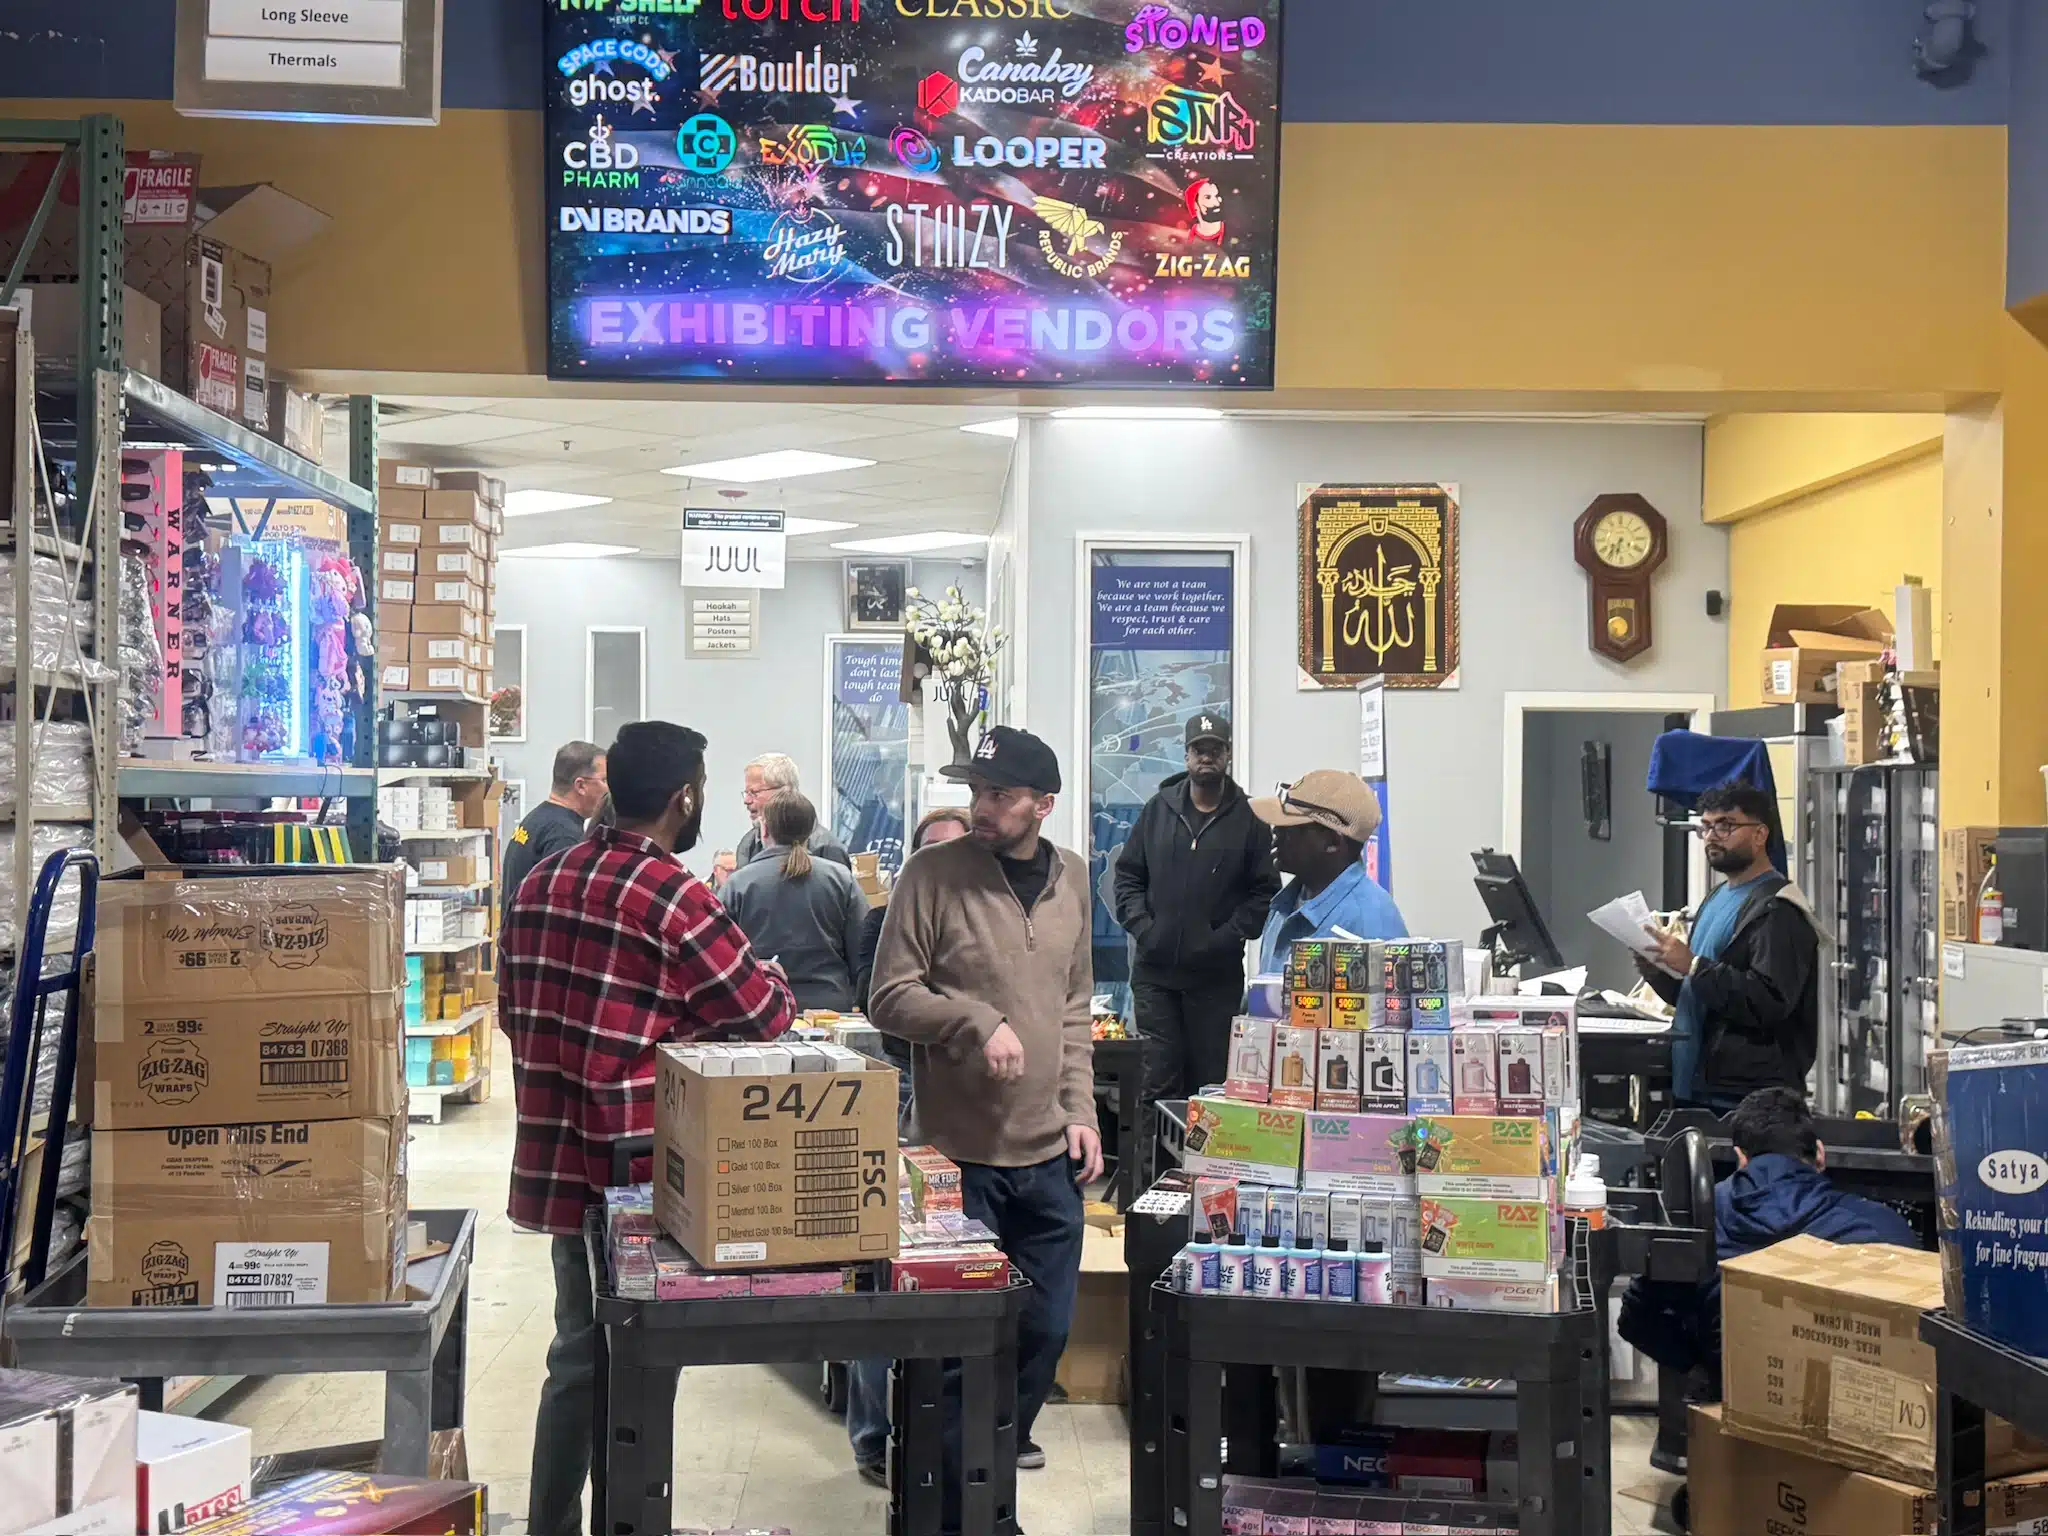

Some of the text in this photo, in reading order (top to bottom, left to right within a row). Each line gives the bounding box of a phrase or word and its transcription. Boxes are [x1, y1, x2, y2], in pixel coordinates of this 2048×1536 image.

[261, 8, 349, 24] Long Sleeve
[895, 0, 1073, 20] CLASSIC
[1124, 3, 1266, 53] STONED
[268, 53, 337, 67] Thermals
[558, 38, 671, 82] SPACE GODS
[740, 44, 858, 94] Boulder
[957, 46, 1094, 97] Canabzy
[569, 73, 661, 106] ghost.
[960, 86, 1054, 103] KADOBAR
[563, 142, 639, 170] CBD
[953, 135, 1107, 168] LOOPER
[1166, 152, 1233, 161] CREATIONS
[140, 168, 192, 187] FRAGILE
[563, 170, 639, 189] PHARM
[603, 207, 730, 235] BRANDS
[763, 223, 847, 260] Hazy
[766, 244, 847, 279] Mary
[1038, 229, 1124, 279] REPUBLIC BRANDS
[1154, 252, 1250, 278] ZIG-ZAG
[590, 300, 1236, 352] EXHIBITING VENDORS
[211, 348, 237, 373] FRAGILE
[705, 546, 761, 573] JUUL
[1116, 578, 1131, 589] We
[1154, 581, 1169, 589] not
[1182, 580, 1207, 589] team
[166, 507, 182, 679] WARNER
[1097, 590, 1225, 603] because we work together.
[1098, 602, 1112, 612] We
[1144, 603, 1168, 612] team
[1171, 602, 1209, 612] because
[1212, 604, 1225, 612] we
[1111, 614, 1210, 626] respect, trust & care
[707, 627, 737, 636] Posters
[1123, 625, 1196, 637] for each other.
[707, 641, 736, 649] Jackets
[844, 655, 876, 668] Tough
[850, 667, 877, 678] don't
[844, 680, 873, 692] tough
[869, 691, 883, 702] do
[1200, 716, 1213, 730] LA
[977, 735, 998, 759] LA
[276, 914, 314, 925] WRAPS
[193, 923, 256, 941] Straight
[144, 1020, 203, 1034] 2 99¢
[259, 1020, 321, 1039] Straight
[262, 1039, 349, 1057] 84762 07368
[141, 1057, 206, 1081] ZIG-ZAG
[154, 1084, 193, 1093] WRAPS
[742, 1077, 862, 1123] 24/7
[1257, 1111, 1296, 1130] RAZ
[1312, 1118, 1350, 1135] RAZ
[168, 1127, 219, 1149] Open
[271, 1124, 309, 1145] End
[1492, 1121, 1533, 1138] RAZ
[731, 1138, 778, 1149] Red 100 Box
[731, 1160, 780, 1172] Gold 100 Box
[1988, 1158, 2039, 1185] Satya
[863, 1150, 887, 1208] FSC
[928, 1171, 958, 1185] MR FOG
[731, 1182, 783, 1194] Silver 100 Box
[731, 1204, 783, 1216] Menthol 100 Box
[1497, 1204, 1539, 1222] RAZ
[731, 1227, 755, 1239] Menthol
[756, 1227, 769, 1237] Gold
[783, 1226, 794, 1235] Box
[1965, 1209, 2016, 1239] Rekindling
[2018, 1218, 2042, 1239] your
[144, 1253, 187, 1269] ZIG-ZAG
[244, 1248, 281, 1261] Straight
[1975, 1240, 1991, 1266] for
[1991, 1241, 2012, 1268] fine
[228, 1261, 235, 1270] 4
[153, 1271, 177, 1280] WRAPS
[228, 1275, 262, 1285] 84762
[263, 1273, 294, 1287] 07832
[1813, 1311, 1881, 1338] MADE IN CHINA
[1767, 1355, 1784, 1370] KGS
[1767, 1374, 1784, 1388] KGS
[1899, 1400, 1926, 1429] CM
